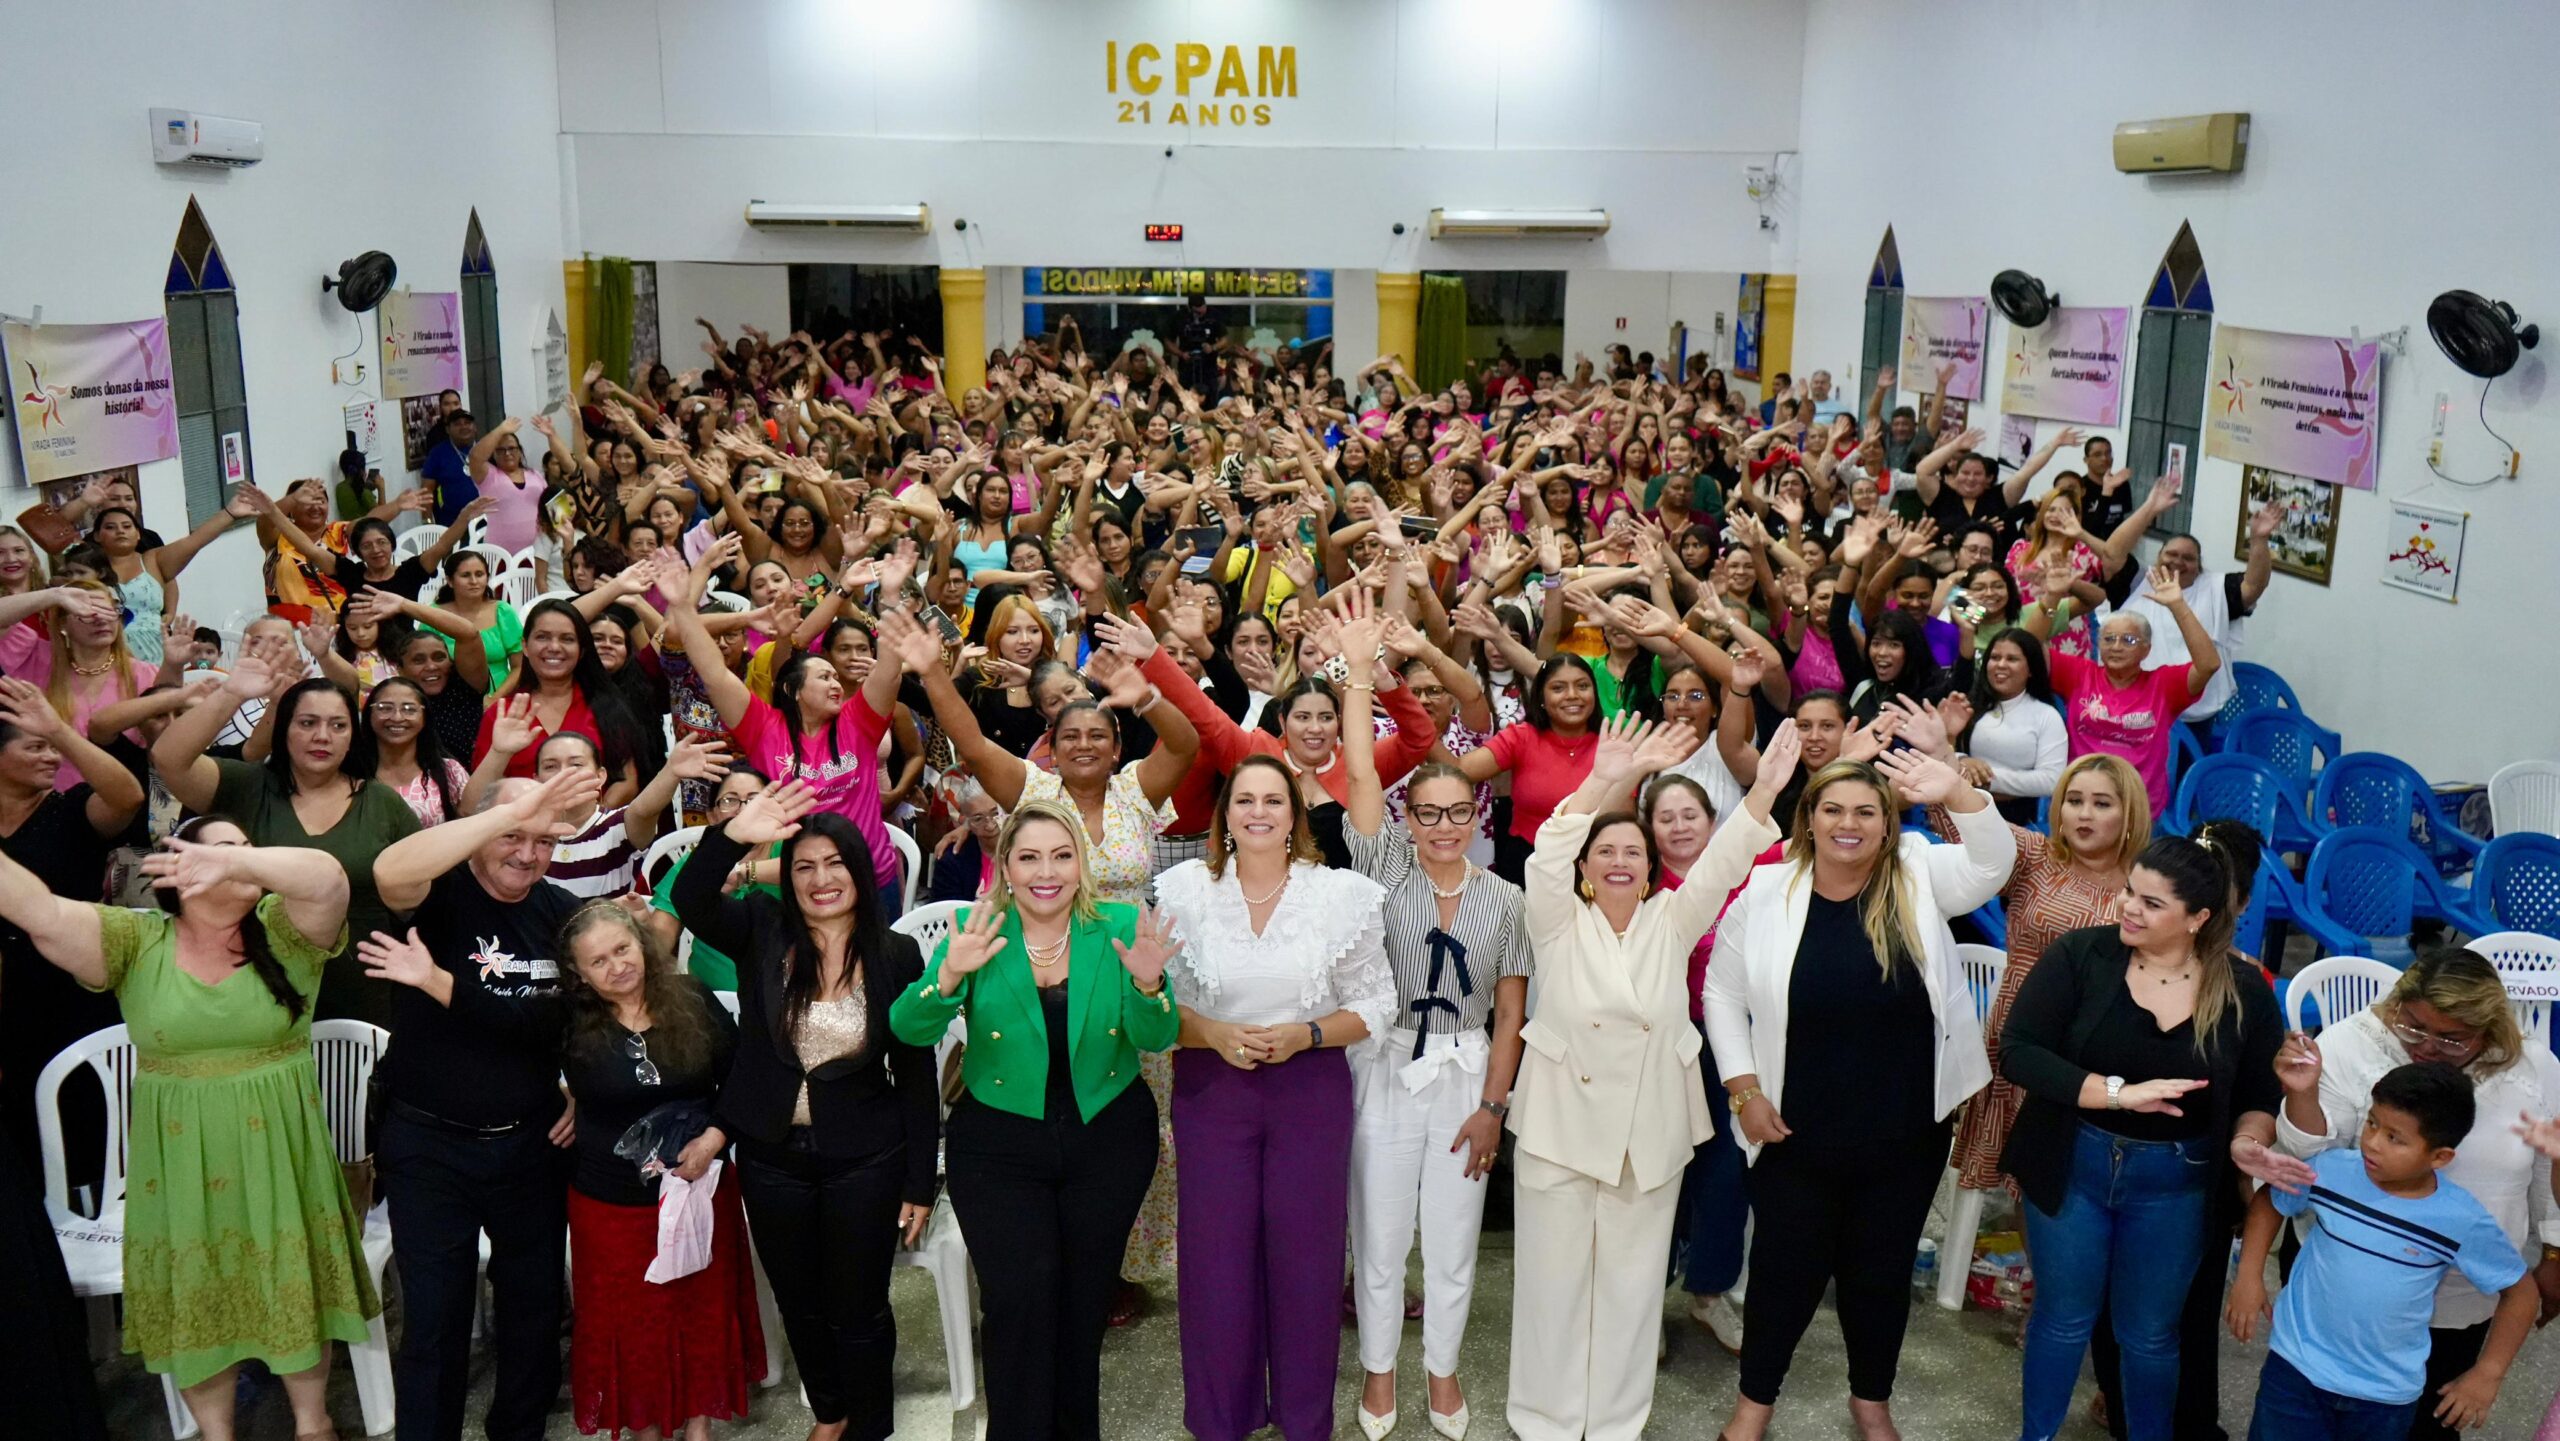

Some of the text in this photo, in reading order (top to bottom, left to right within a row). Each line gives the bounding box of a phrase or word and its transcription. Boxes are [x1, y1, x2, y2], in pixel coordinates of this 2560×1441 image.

[1106, 41, 1297, 98] ICPAM
[1117, 100, 1271, 126] 21 ANOS
[70, 378, 169, 399] Somos donas da nossa
[2266, 377, 2290, 391] Virada
[2291, 381, 2328, 396] Feminina
[2342, 389, 2368, 401] nossa
[105, 396, 144, 416] história!
[2297, 402, 2325, 418] juntas,
[2326, 406, 2347, 419] nada
[2295, 419, 2322, 435] detém.
[501, 960, 529, 972] VIRADA
[2507, 986, 2559, 996] RVADO
[54, 1228, 125, 1243] RESERV
